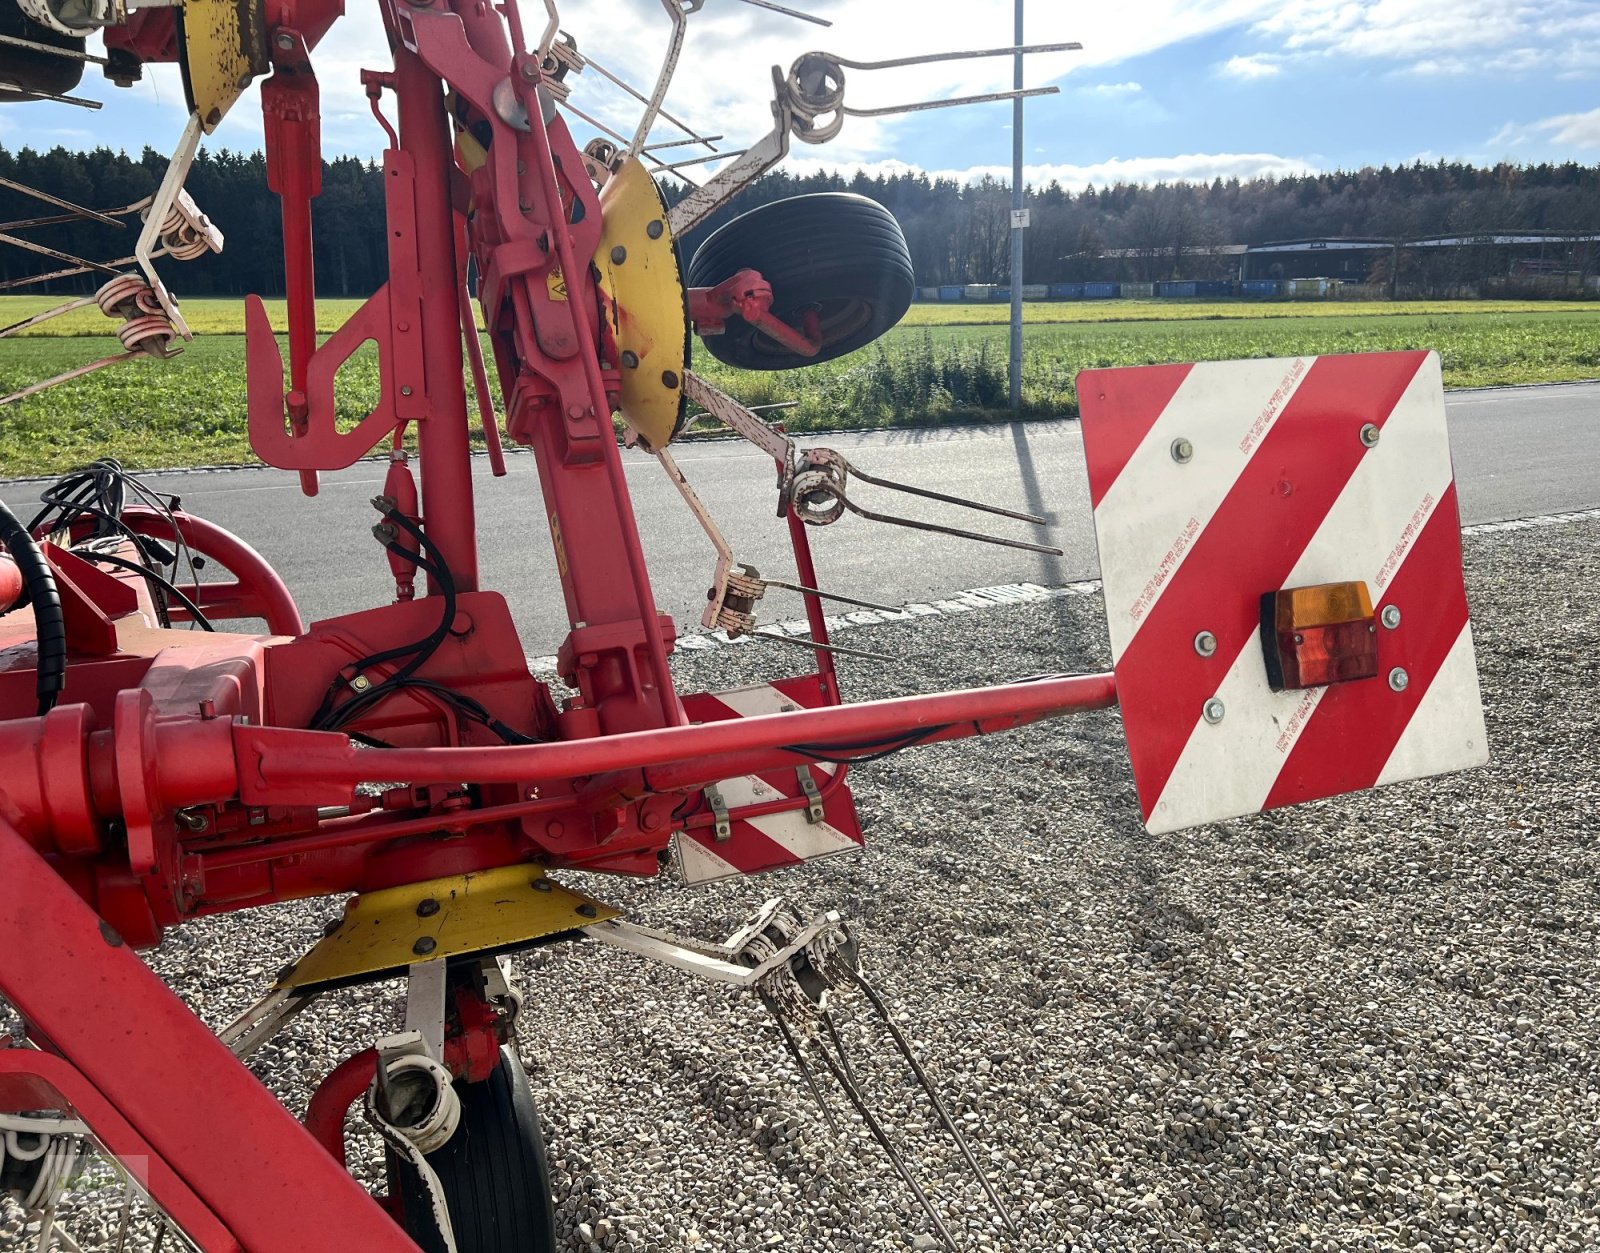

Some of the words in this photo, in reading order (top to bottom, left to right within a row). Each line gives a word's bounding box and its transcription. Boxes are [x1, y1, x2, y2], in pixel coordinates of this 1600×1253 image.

[1263, 405, 1277, 423] GEKA
[1396, 539, 1408, 557] GEKA
[1159, 550, 1173, 569] GEKA
[1134, 608, 1143, 621] DIN
[1155, 568, 1169, 587] GEKA
[1299, 700, 1311, 719] GEKA
